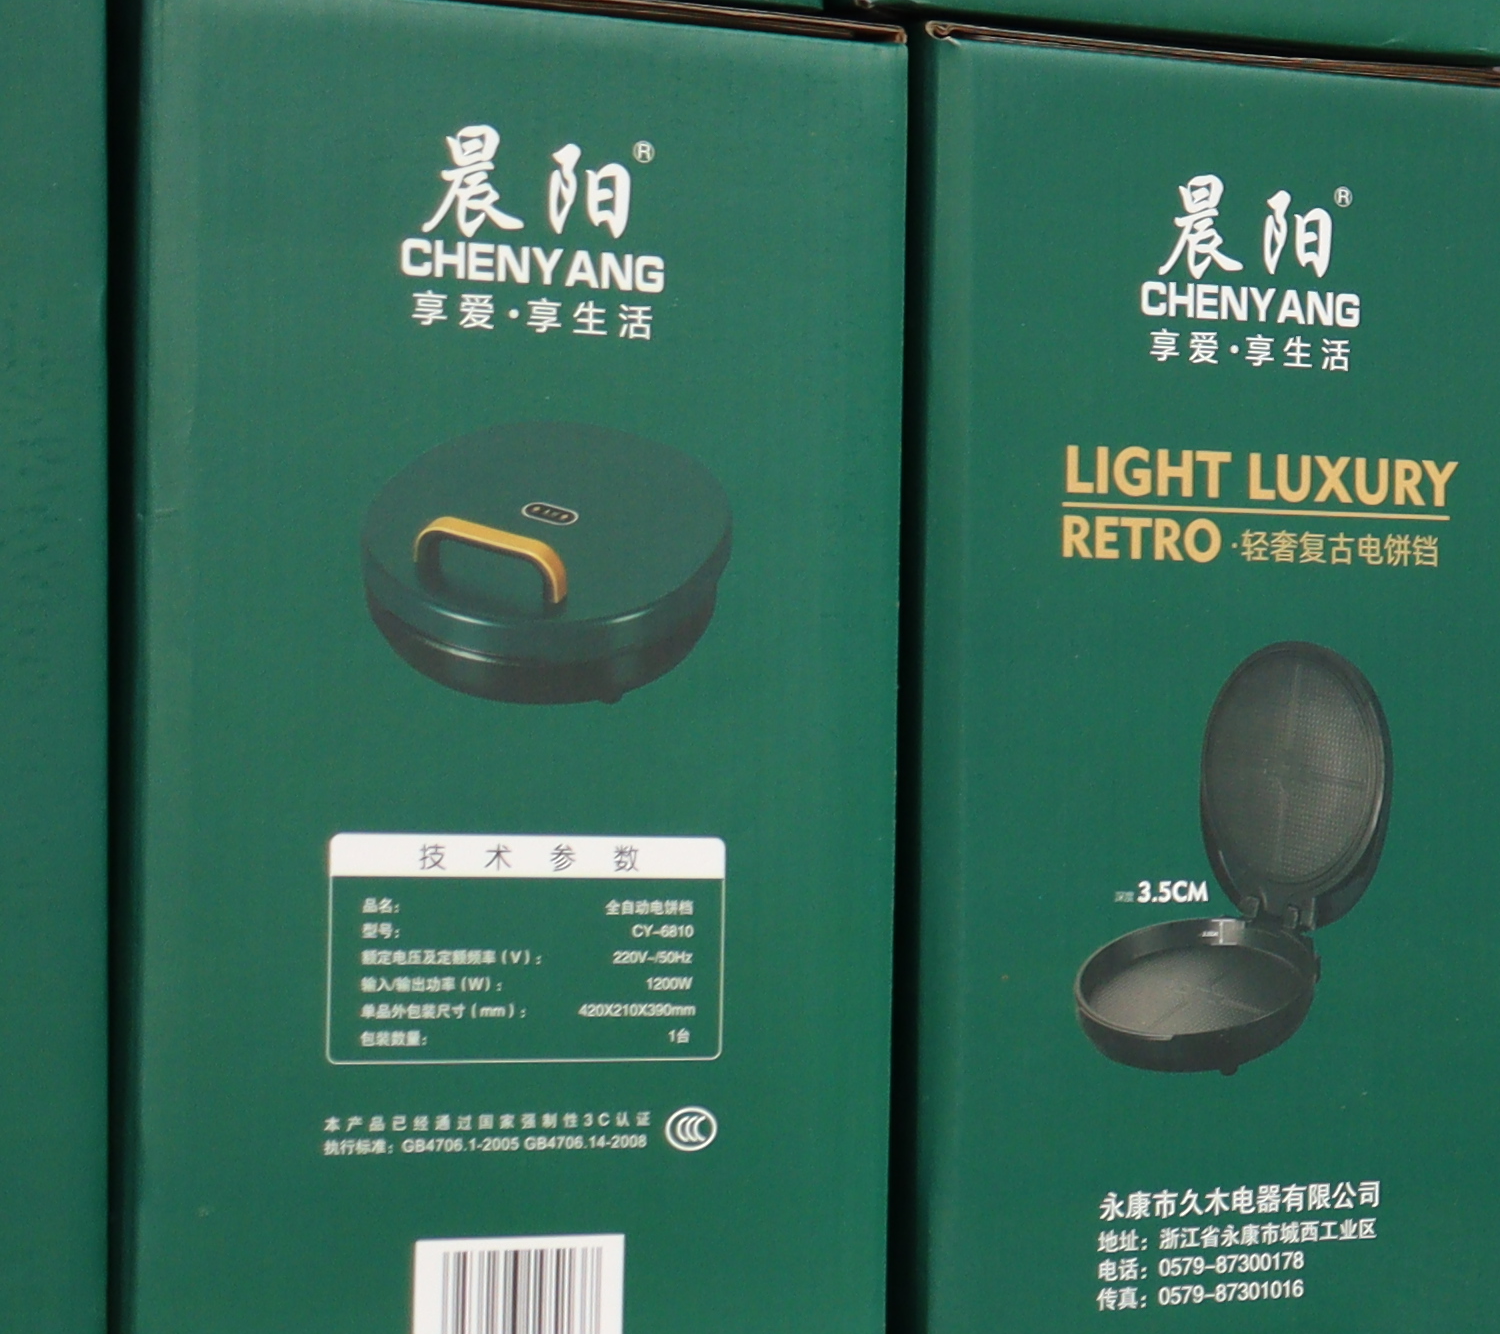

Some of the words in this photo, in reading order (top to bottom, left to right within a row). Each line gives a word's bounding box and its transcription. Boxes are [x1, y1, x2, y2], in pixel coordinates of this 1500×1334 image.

[421, 124, 632, 238] 晨阳
[1157, 174, 1334, 279] 晨阳
[400, 238, 665, 294] CHENYANG
[411, 290, 654, 340] 享爱·享生活
[1140, 281, 1361, 328] CHENYANG
[1149, 328, 1351, 372] 享爱·享生活
[1065, 444, 1232, 498] LIGHT
[1248, 452, 1459, 507] LUXURY
[1061, 515, 1221, 563] RETRO
[419, 843, 640, 873] 技术参数
[1137, 880, 1209, 903] 3.5CM
[631, 923, 694, 940] CY-6810
[645, 977, 693, 992] 1200W
[1100, 1180, 1381, 1222] 永康市久木电器有限公司
